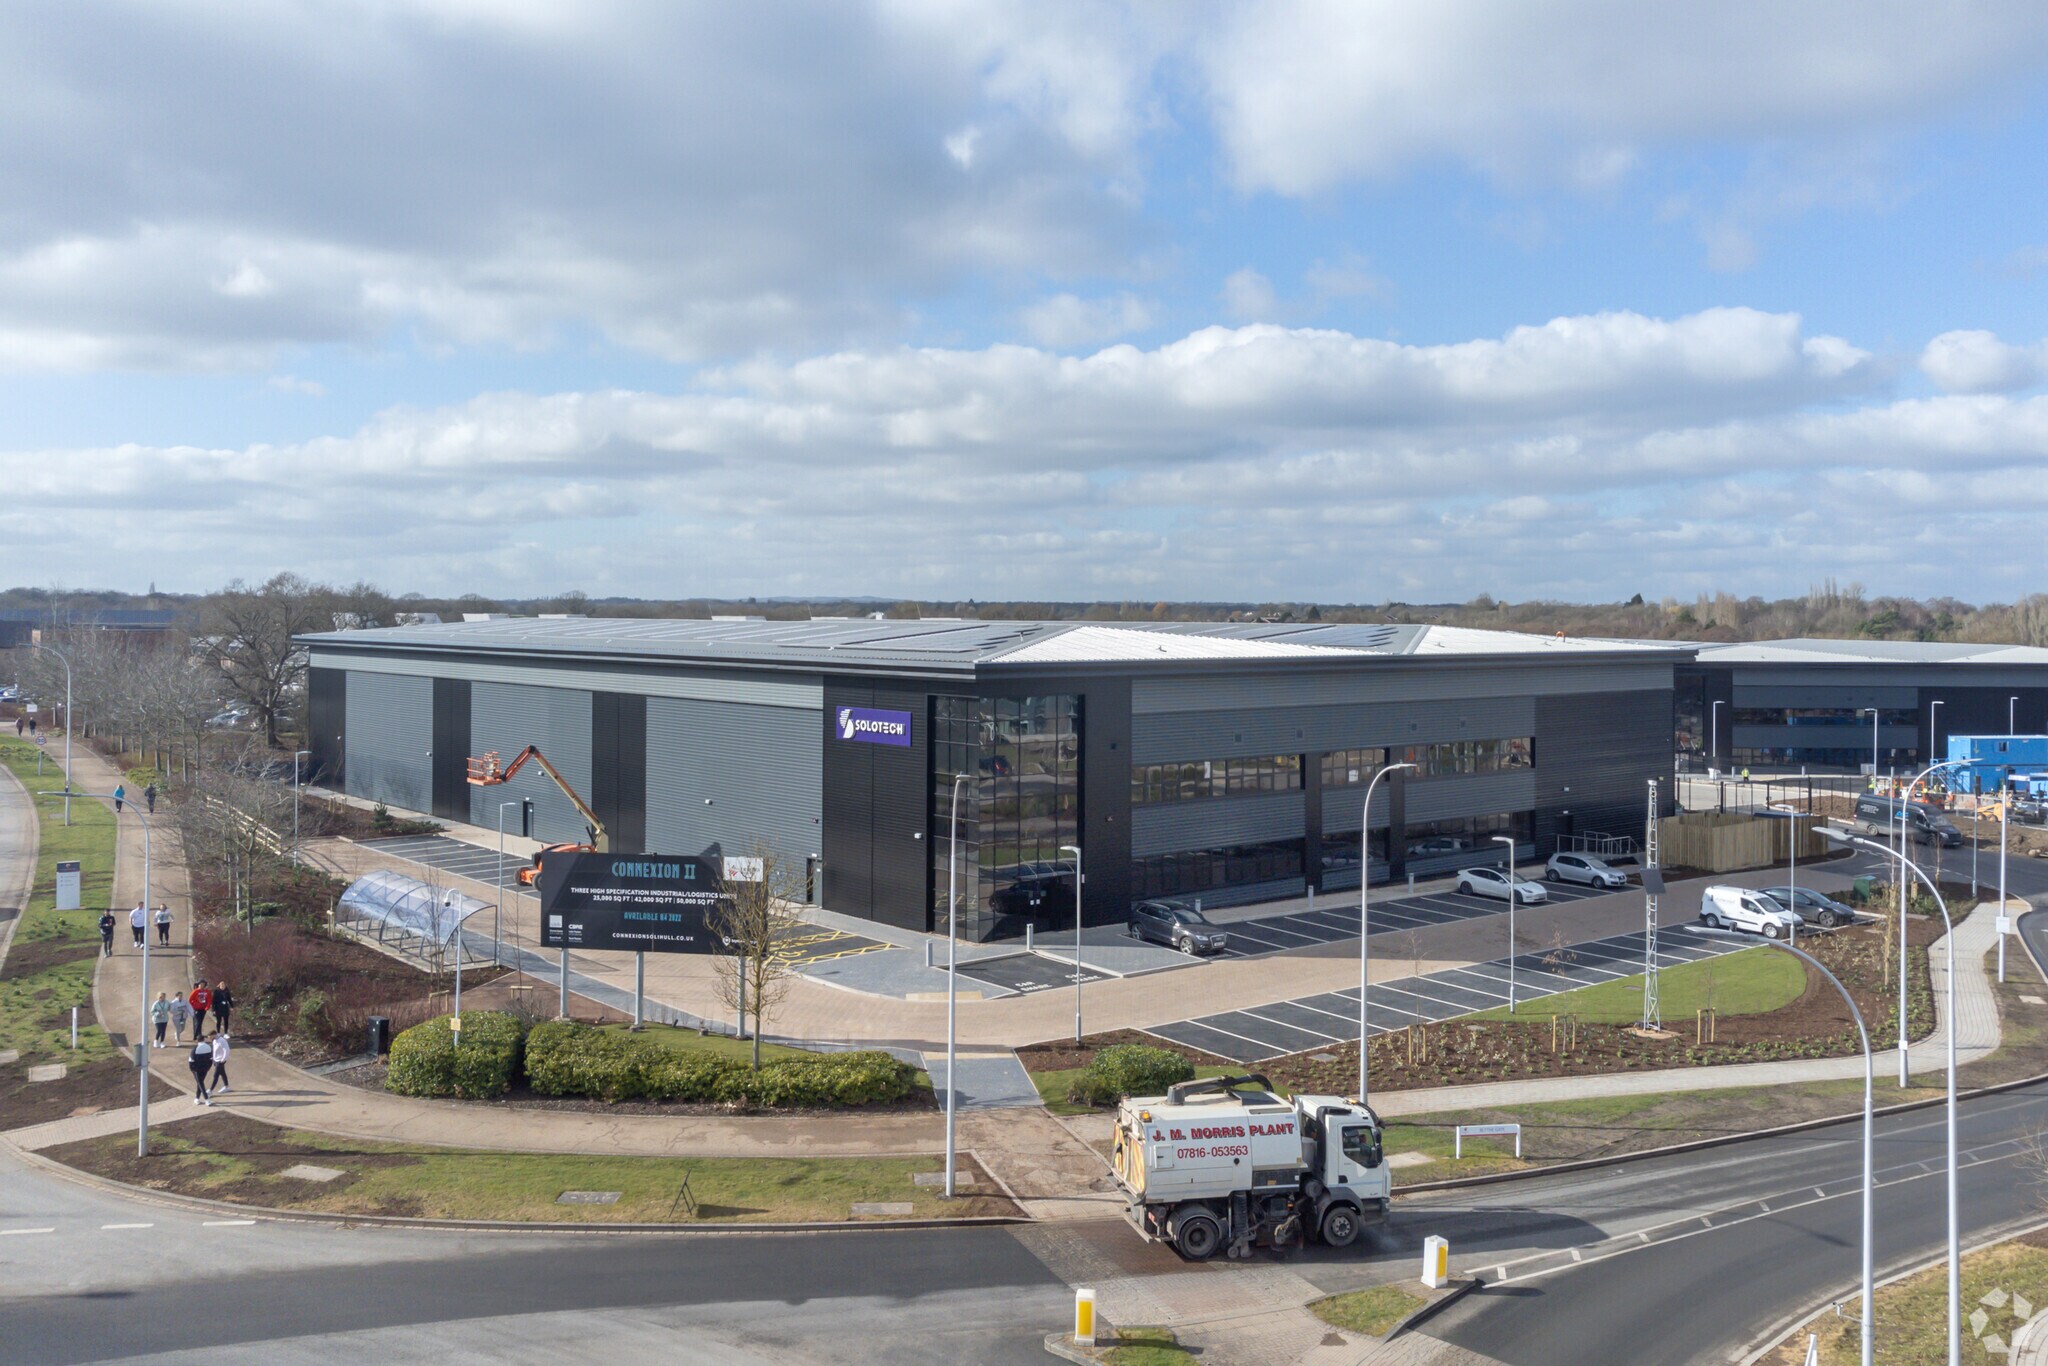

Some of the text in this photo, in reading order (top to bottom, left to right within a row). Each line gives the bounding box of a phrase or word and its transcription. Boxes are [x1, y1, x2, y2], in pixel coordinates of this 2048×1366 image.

[855, 719, 904, 735] SOLOTECH
[611, 861, 696, 880] CONNEXION II
[606, 888, 650, 896] SPECIFICATION
[650, 890, 718, 898] INDUSTRIAL/LOGISTICS
[624, 911, 658, 921] AVAILABLE
[612, 932, 694, 942] CONNEXIONSOLIHULL.CO.UK
[1152, 1123, 1295, 1142] J. M. MORRIS PLANT
[1177, 1145, 1249, 1159] 07816-053563
